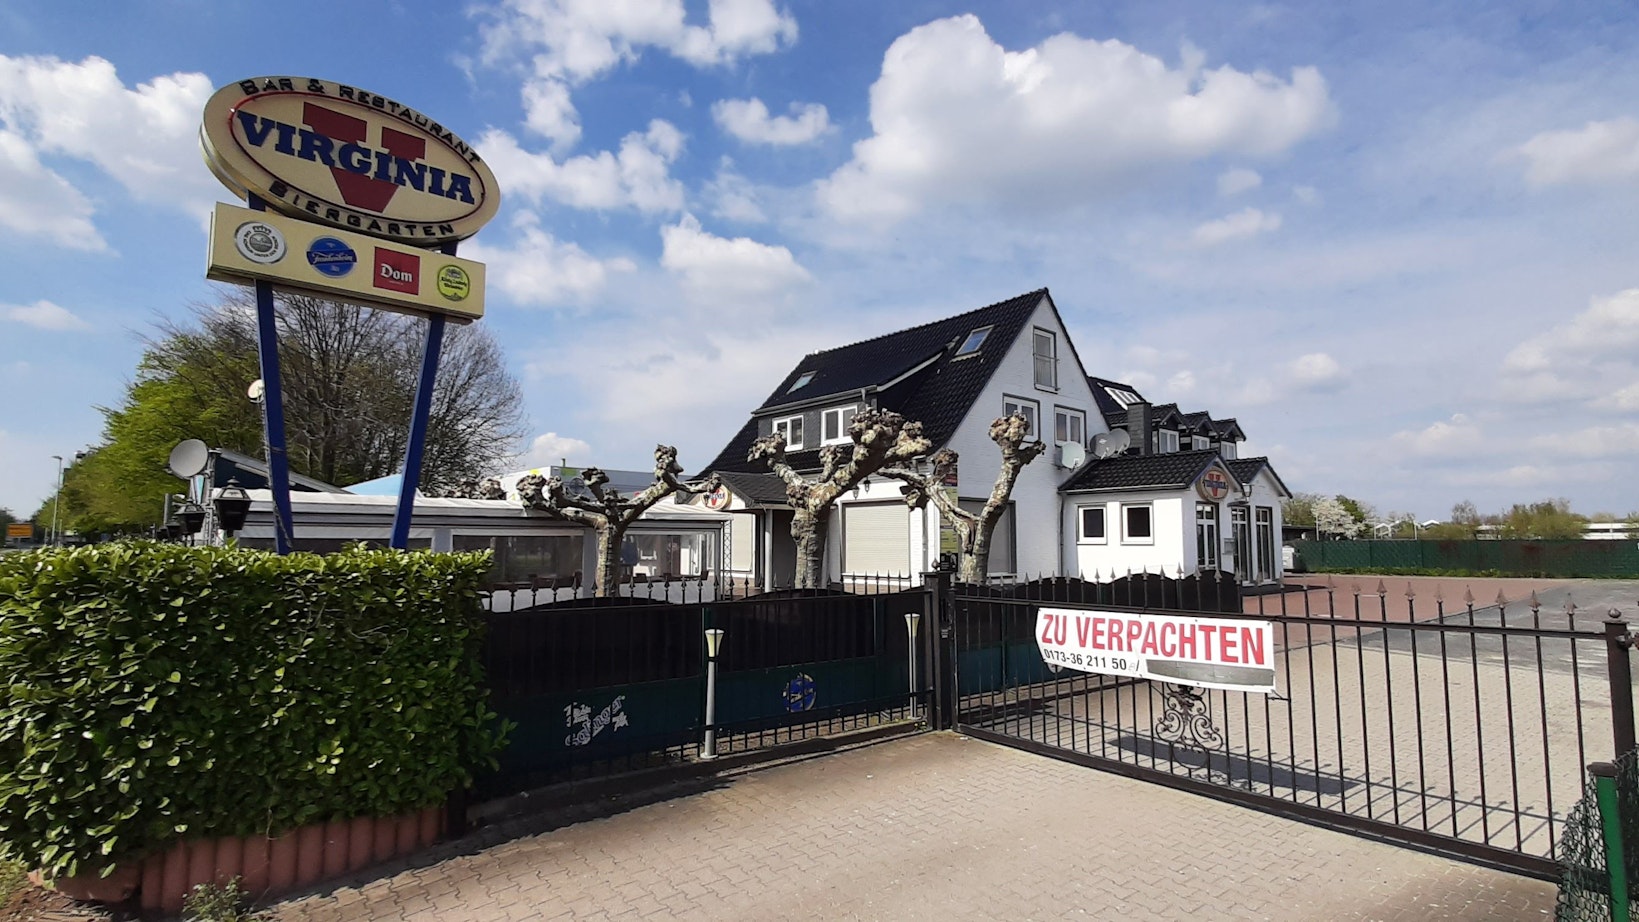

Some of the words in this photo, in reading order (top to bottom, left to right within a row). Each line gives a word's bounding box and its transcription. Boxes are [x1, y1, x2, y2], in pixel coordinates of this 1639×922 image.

[239, 79, 294, 96] BAR
[307, 79, 326, 95] &
[339, 86, 481, 164] RESTAURANT
[236, 111, 475, 205] VIRGINIA
[268, 180, 455, 237] BIERGARTEN
[380, 263, 413, 282] Dom
[1041, 614, 1068, 646] ZU
[1076, 616, 1264, 665] VERPACHTEN
[1044, 648, 1083, 666] 0173-36
[1086, 655, 1106, 669] 211
[1111, 657, 1127, 671] 50
